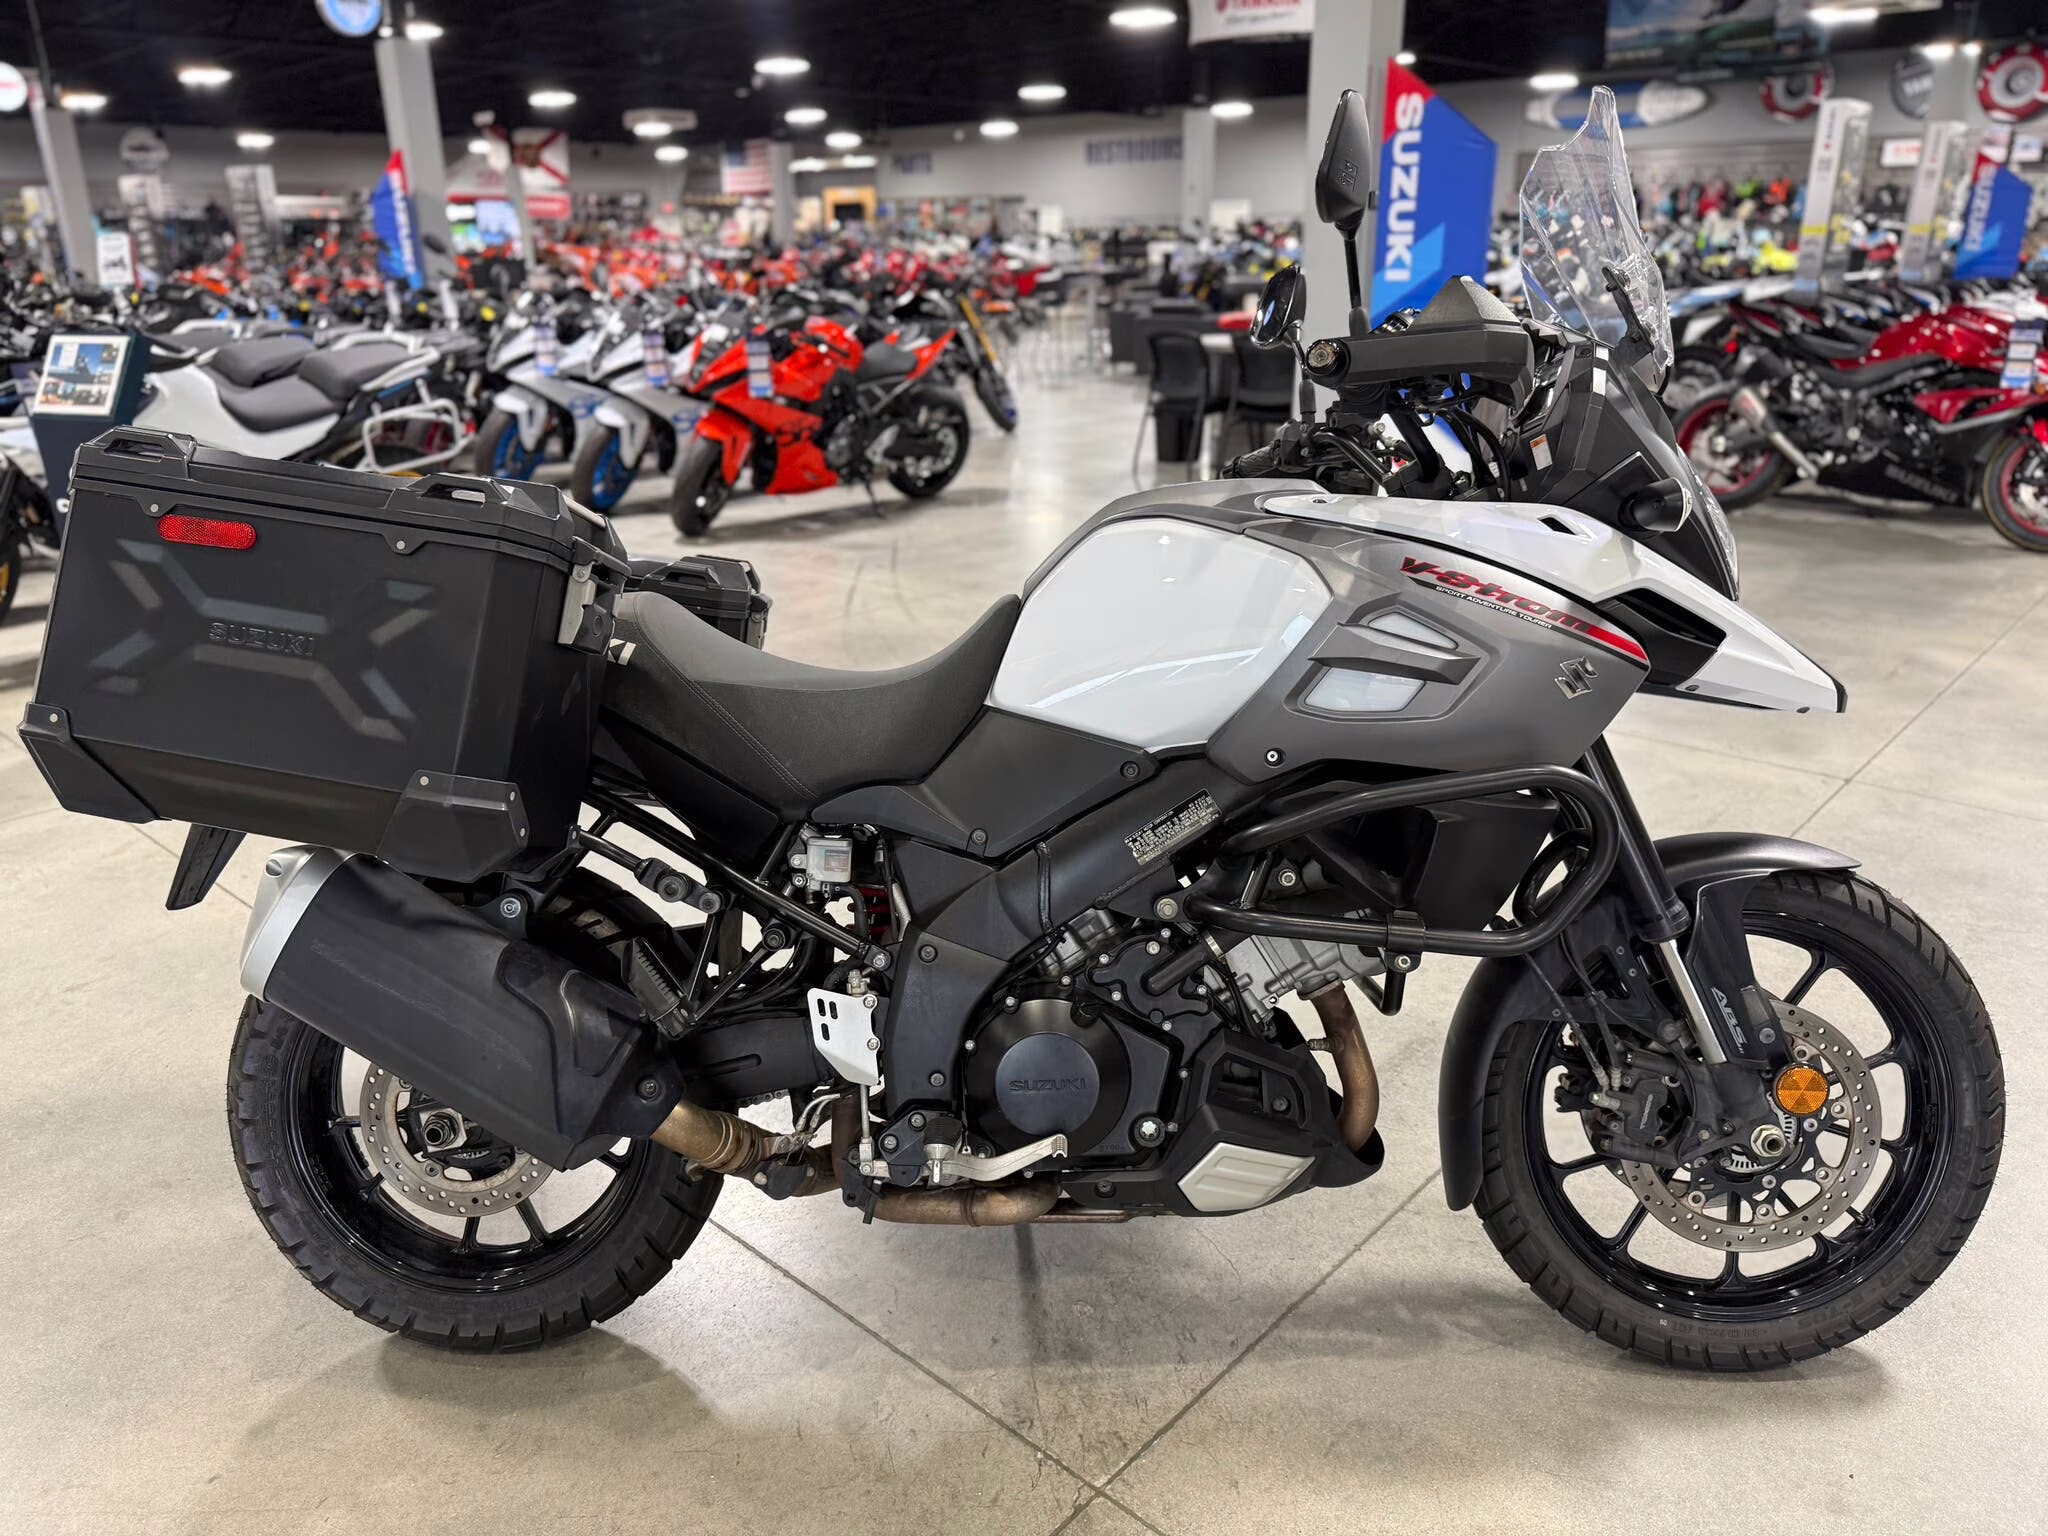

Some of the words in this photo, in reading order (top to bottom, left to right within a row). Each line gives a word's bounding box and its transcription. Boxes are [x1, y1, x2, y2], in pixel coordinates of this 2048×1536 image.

[1384, 92, 1425, 283] SUZUKI
[1435, 585, 1466, 599] SPORT
[1466, 595, 1518, 617] ADVENTURE
[1518, 612, 1553, 630] TOURER
[208, 621, 315, 657] SUZUKI
[1711, 986, 1748, 1048] ABS
[1008, 1078, 1088, 1092] SUZUKI
